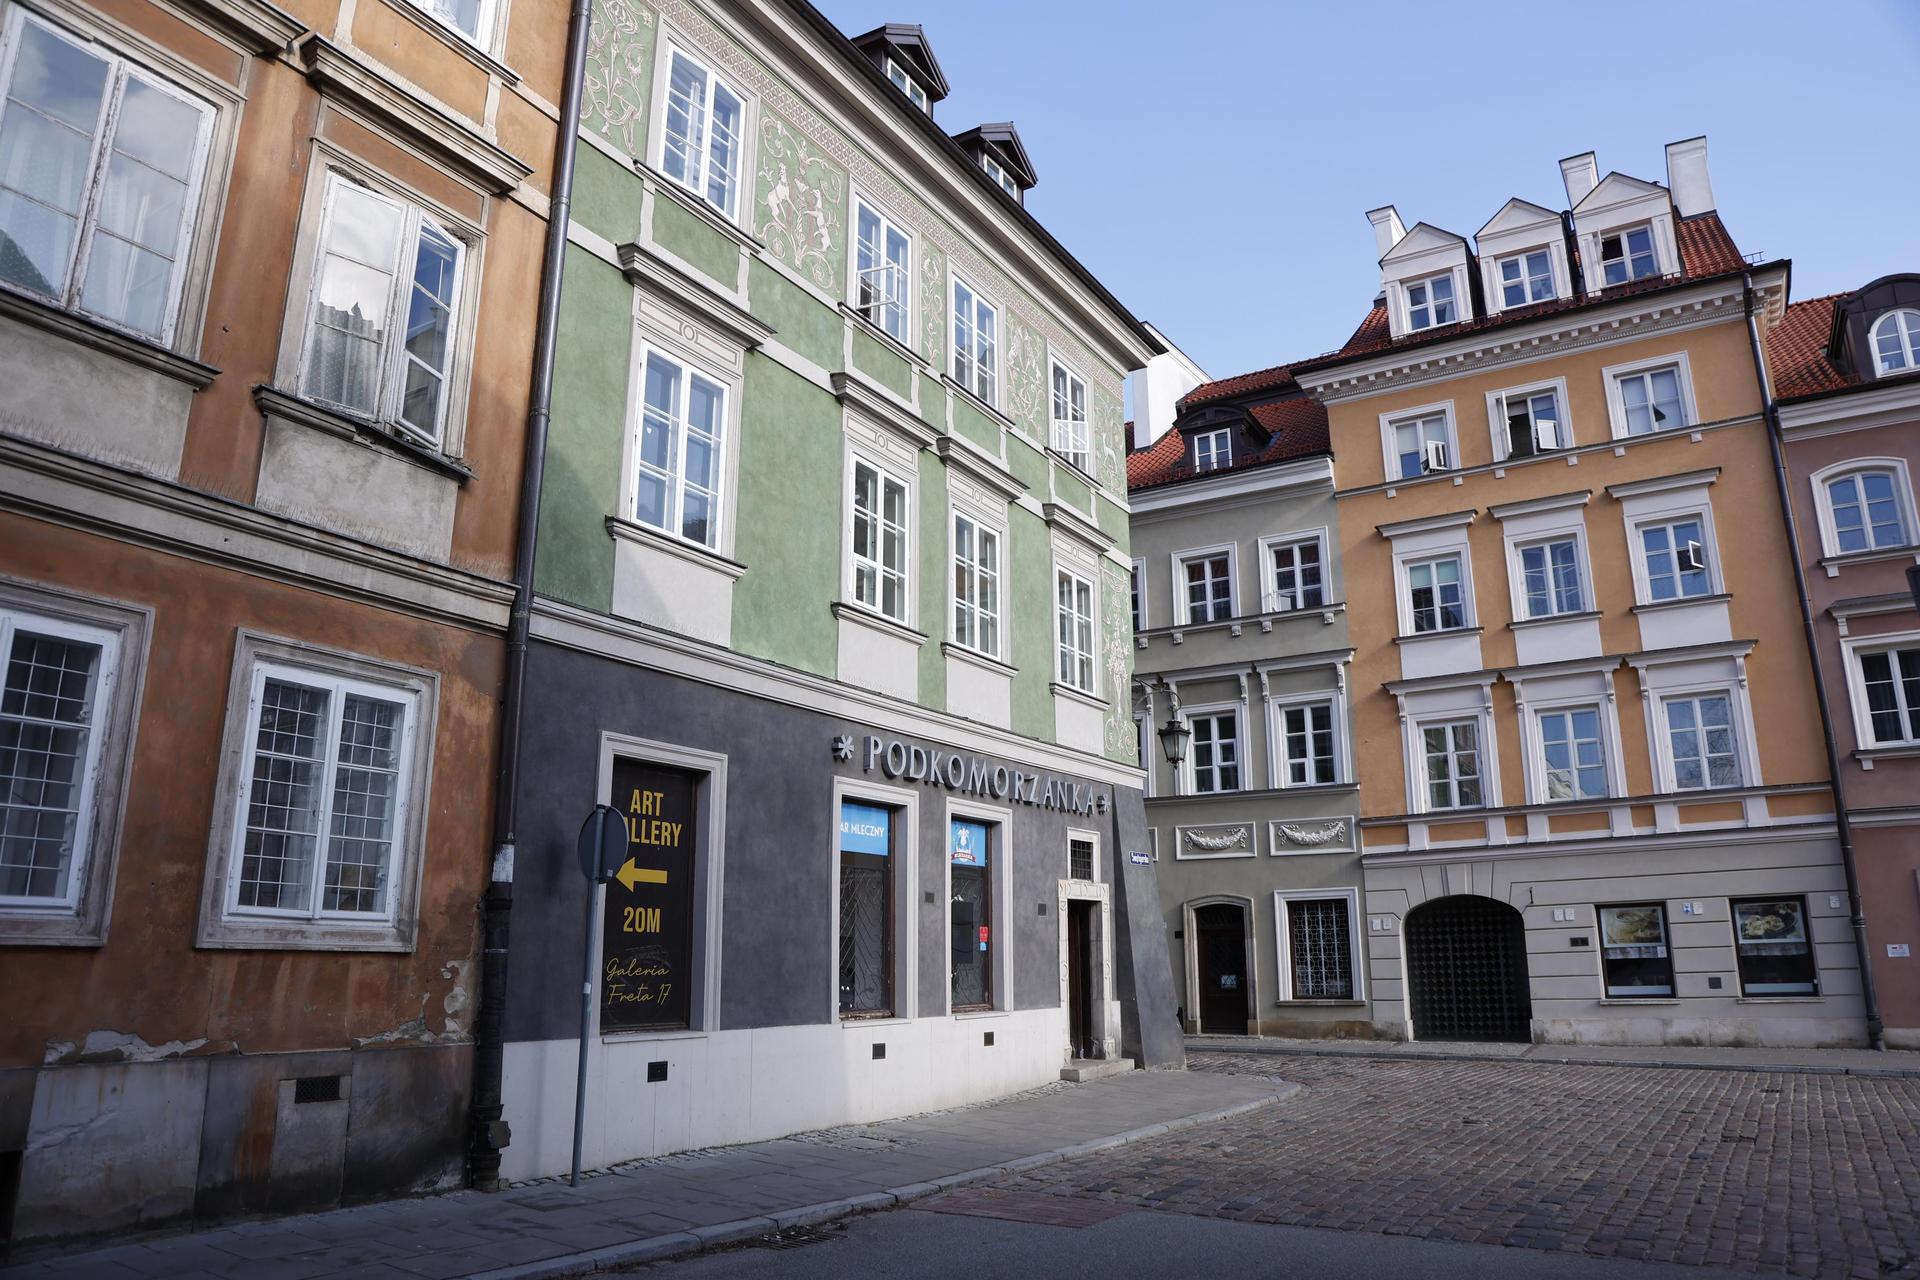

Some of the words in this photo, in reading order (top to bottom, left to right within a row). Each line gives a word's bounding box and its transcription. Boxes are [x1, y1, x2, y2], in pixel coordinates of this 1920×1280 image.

[863, 735, 1095, 816] PODKOMORZANKA
[629, 788, 664, 817] ART
[623, 816, 682, 847] LLERY
[850, 823, 885, 838] MLECZNY
[623, 906, 661, 933] 20M
[606, 957, 670, 982] Galeria
[608, 983, 654, 1005] Freta
[657, 983, 672, 1005] 17
